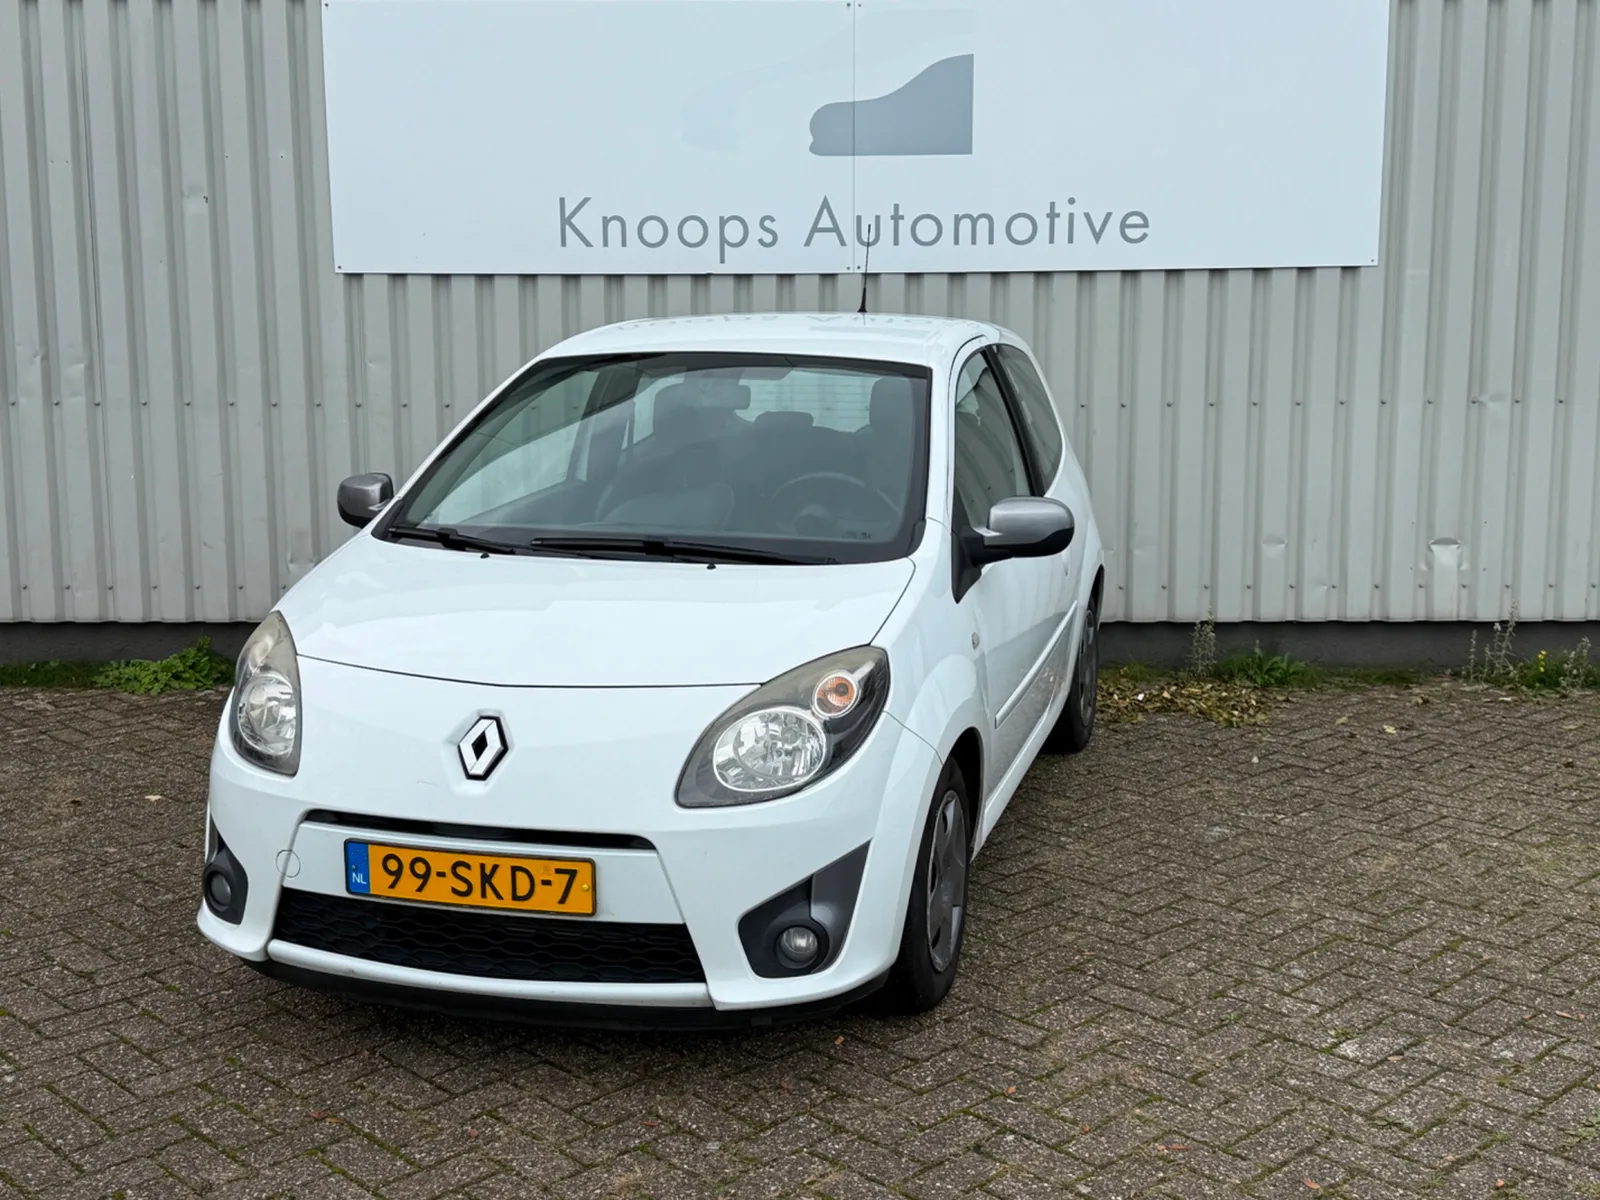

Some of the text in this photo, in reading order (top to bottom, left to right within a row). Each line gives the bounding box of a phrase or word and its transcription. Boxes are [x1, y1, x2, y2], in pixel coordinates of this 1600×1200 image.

[559, 196, 1150, 264] Knoops Automotive
[352, 872, 367, 885] NL
[381, 852, 579, 905] 99-SKD-7
